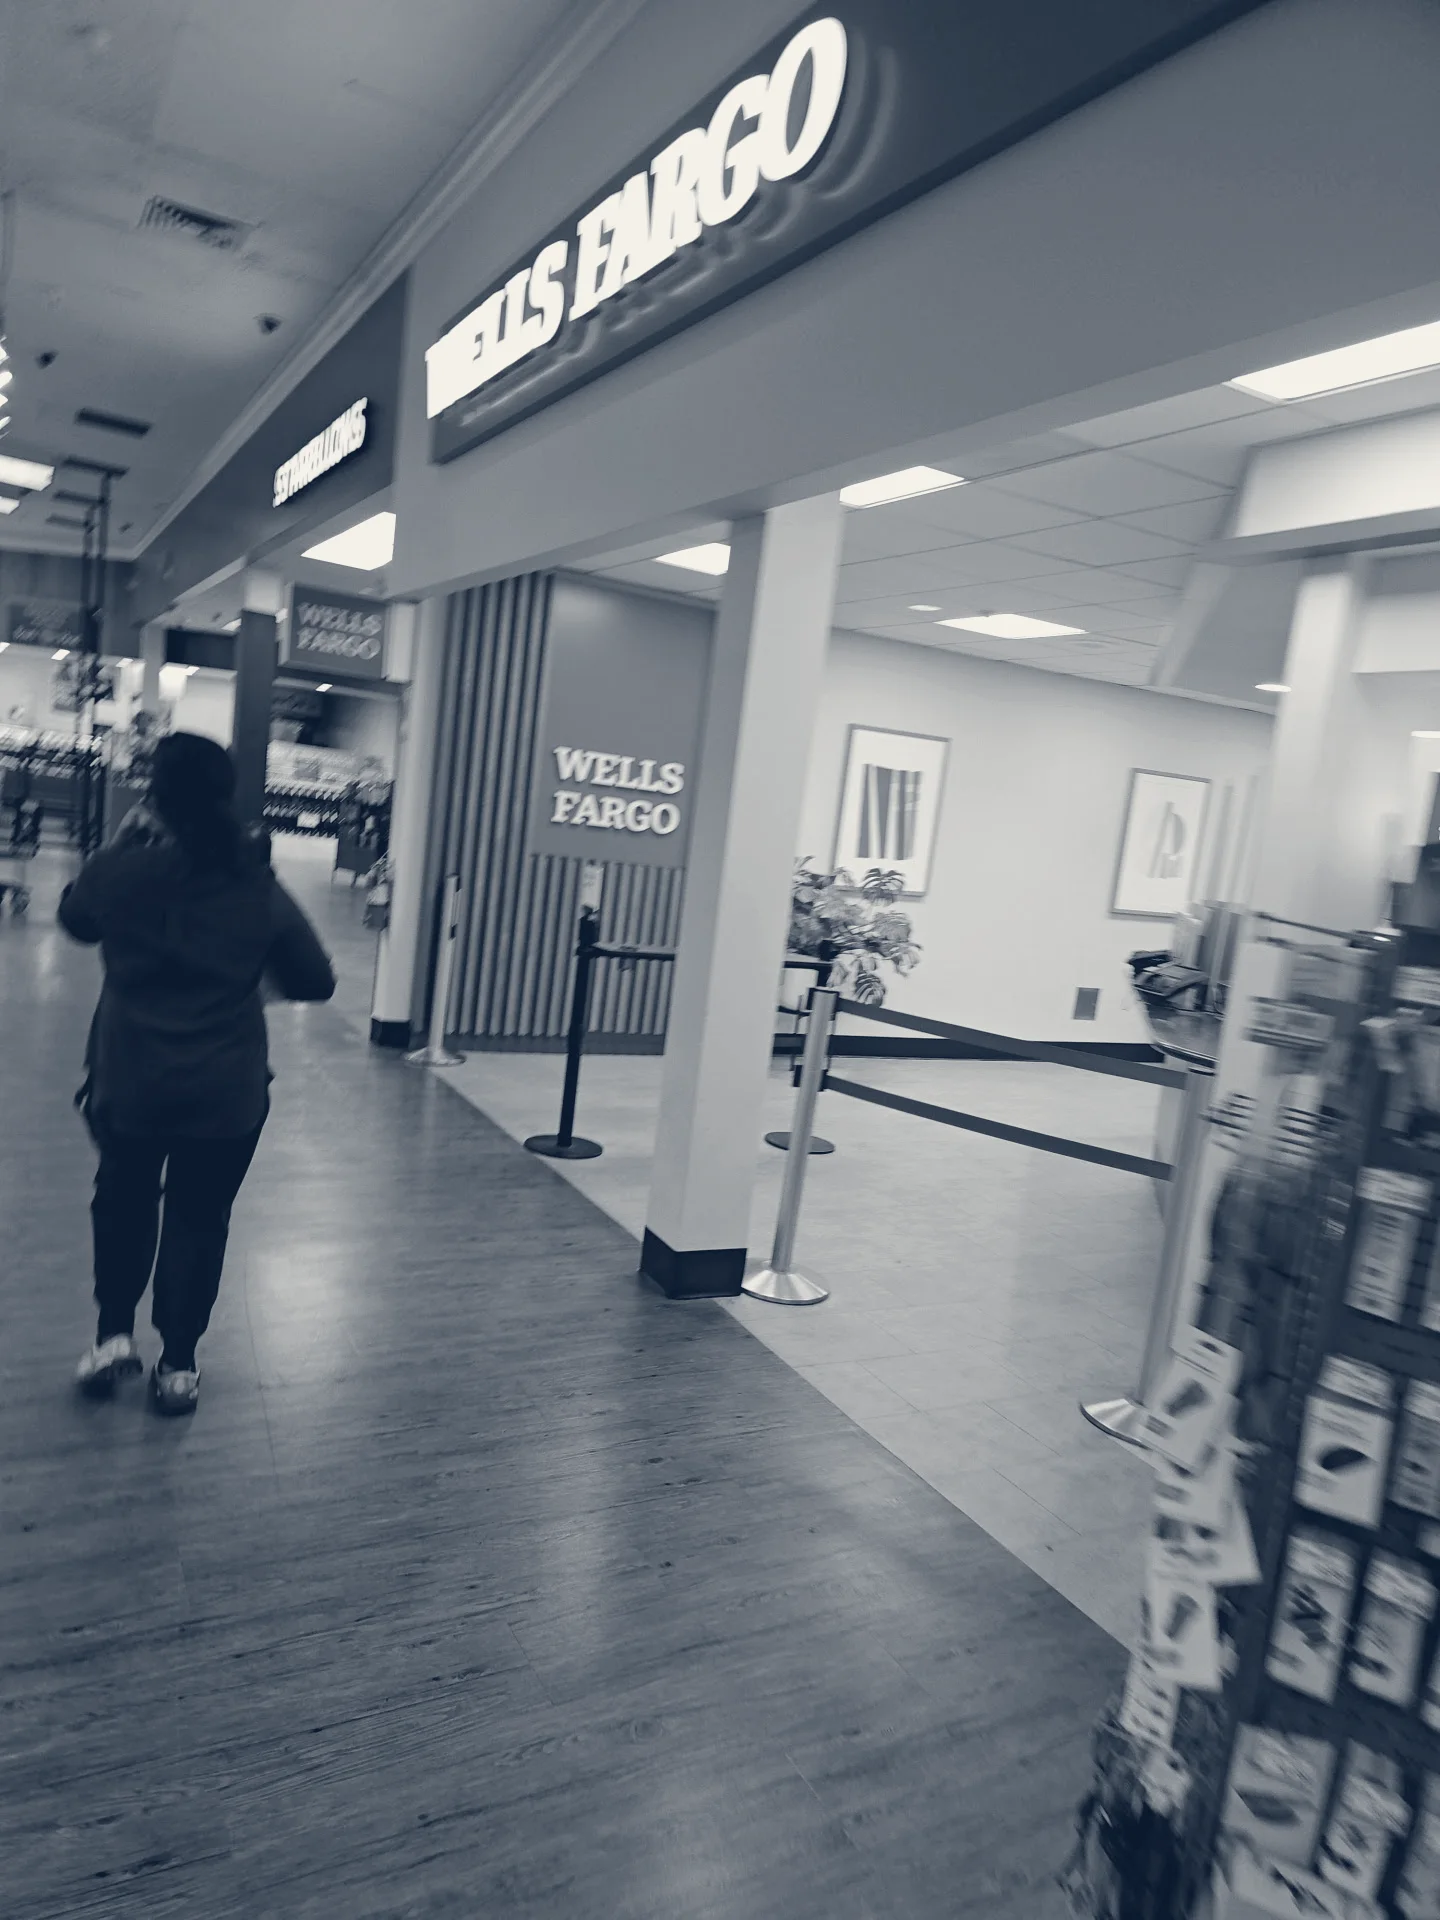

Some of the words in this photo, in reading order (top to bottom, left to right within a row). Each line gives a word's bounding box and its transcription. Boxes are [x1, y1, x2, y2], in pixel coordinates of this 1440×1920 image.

[425, 240, 568, 419] WELLS
[568, 17, 847, 322] FARGO
[552, 745, 685, 795] WELLS
[551, 789, 681, 835] FARGO
